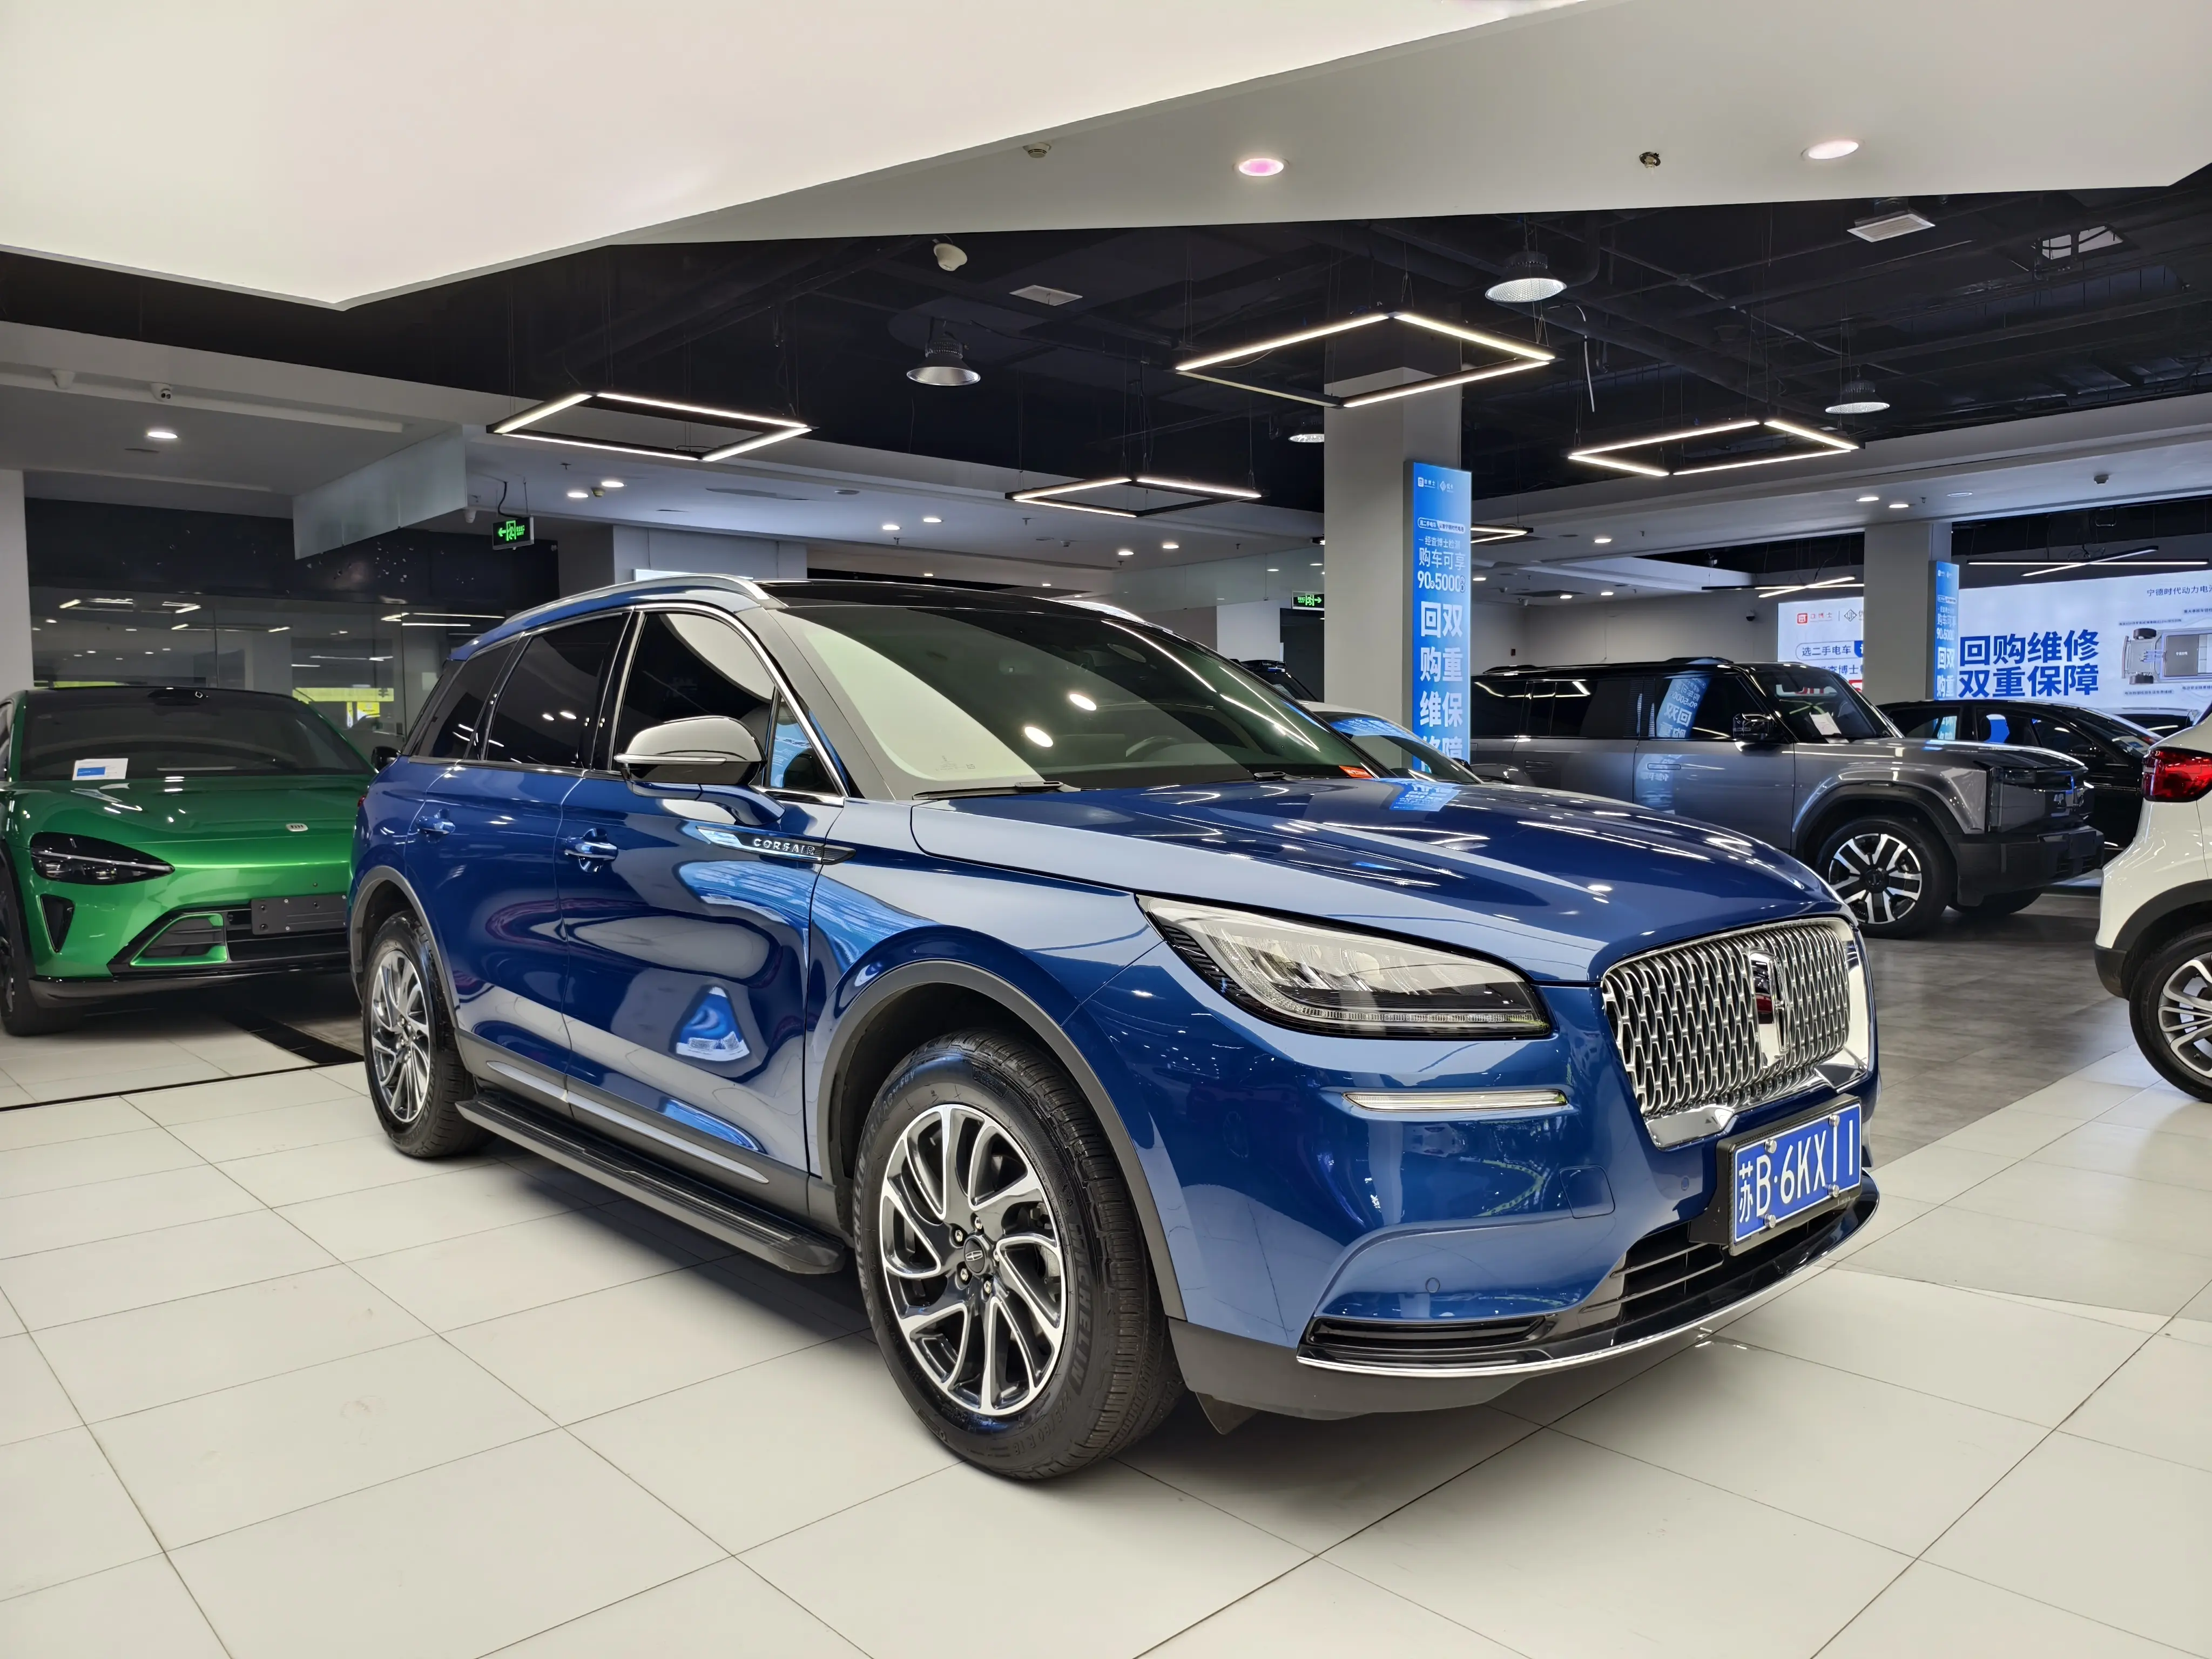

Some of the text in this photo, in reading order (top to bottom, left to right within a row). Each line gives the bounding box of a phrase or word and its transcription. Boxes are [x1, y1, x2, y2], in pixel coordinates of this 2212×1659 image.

[1419, 548, 1466, 570] 购车可享
[1802, 645, 1851, 657] 选二手电车
[1959, 629, 2100, 667] 回购维修
[1958, 664, 2099, 699] 双重保障
[753, 838, 815, 855] CORSAIR
[853, 1151, 868, 1291] MICHELIN
[1070, 1223, 1092, 1390] MICHELIN
